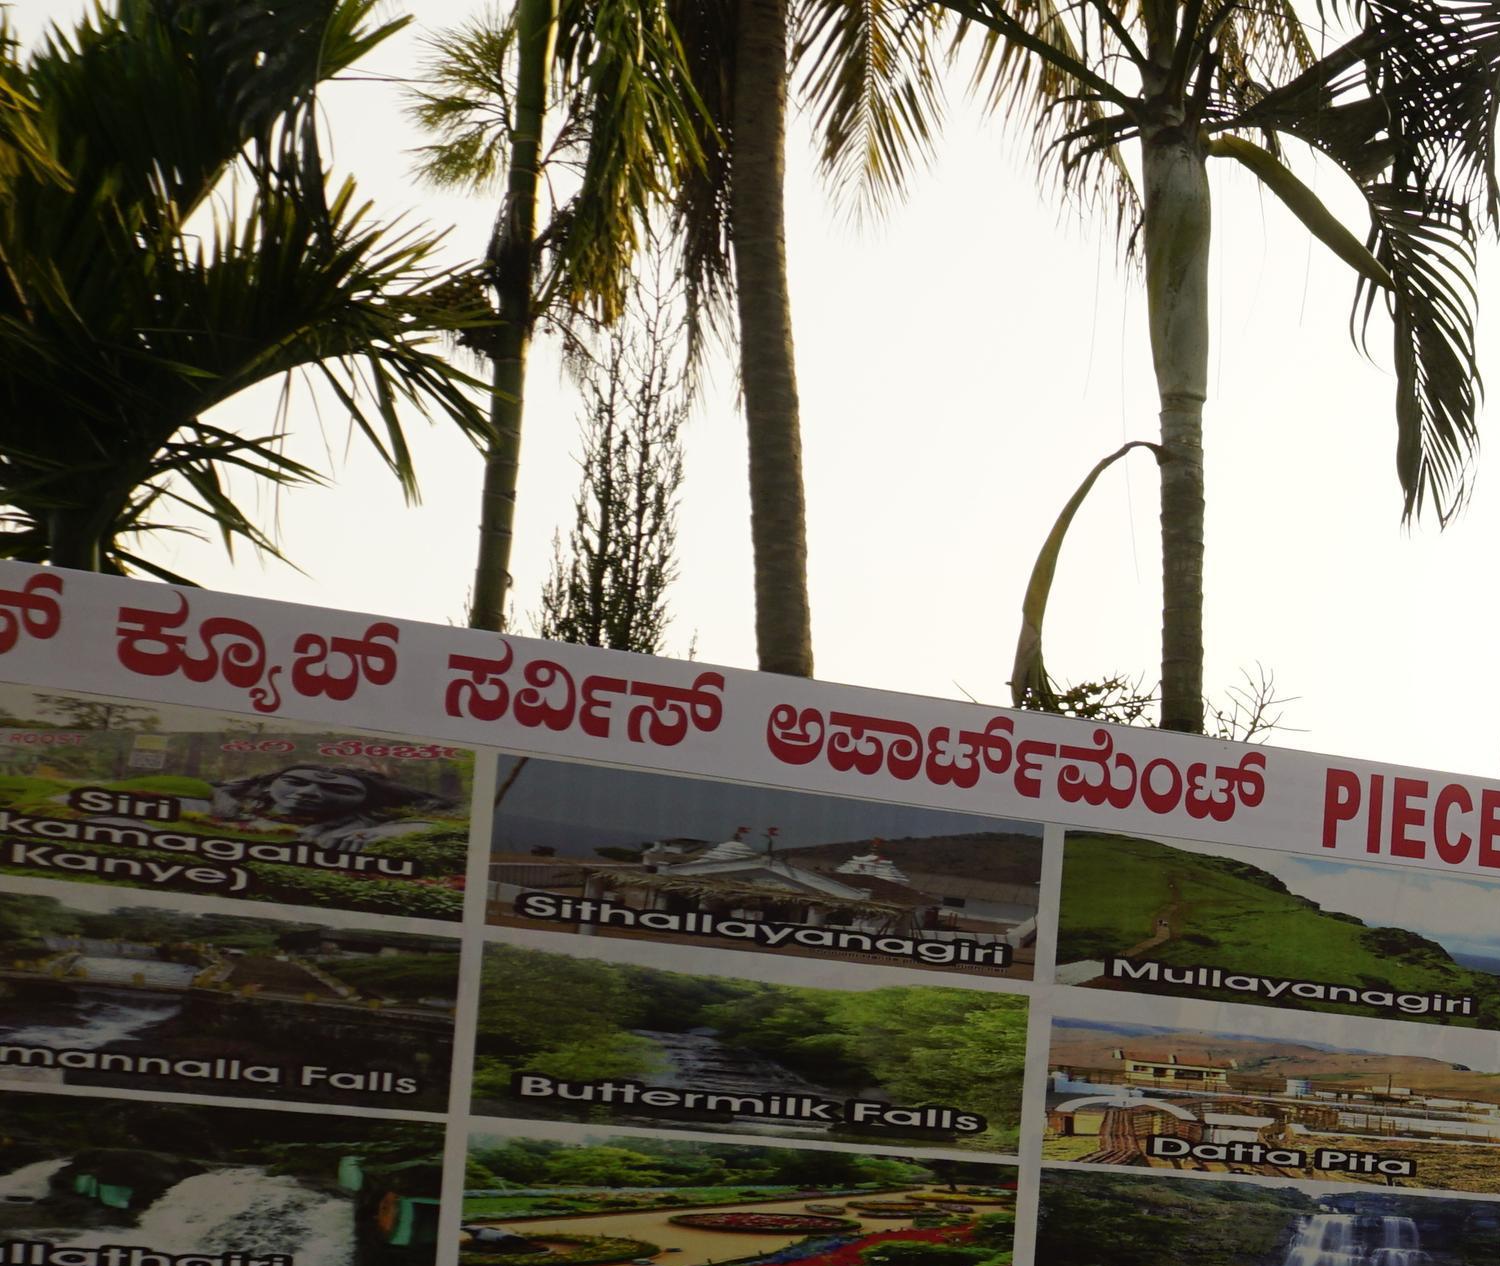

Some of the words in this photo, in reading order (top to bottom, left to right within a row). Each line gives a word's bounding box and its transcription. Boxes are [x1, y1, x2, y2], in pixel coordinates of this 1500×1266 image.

[117, 590, 400, 713] ಕ್ಯೂಬ್
[444, 639, 725, 746] ಸರ್ವಿಸ್
[78, 791, 170, 820] Siri
[0, 812, 415, 877] kamagaluru
[12, 845, 249, 892] Kanye)
[524, 898, 1005, 966] Sithallayanagiri
[1113, 957, 1472, 1015] Mullayanagiri
[301, 1065, 418, 1095] Falls
[520, 1077, 832, 1119] Buttermilk
[852, 1103, 980, 1132] Falls
[1152, 1136, 1303, 1167] Datta
[1315, 1149, 1413, 1175] Pita
